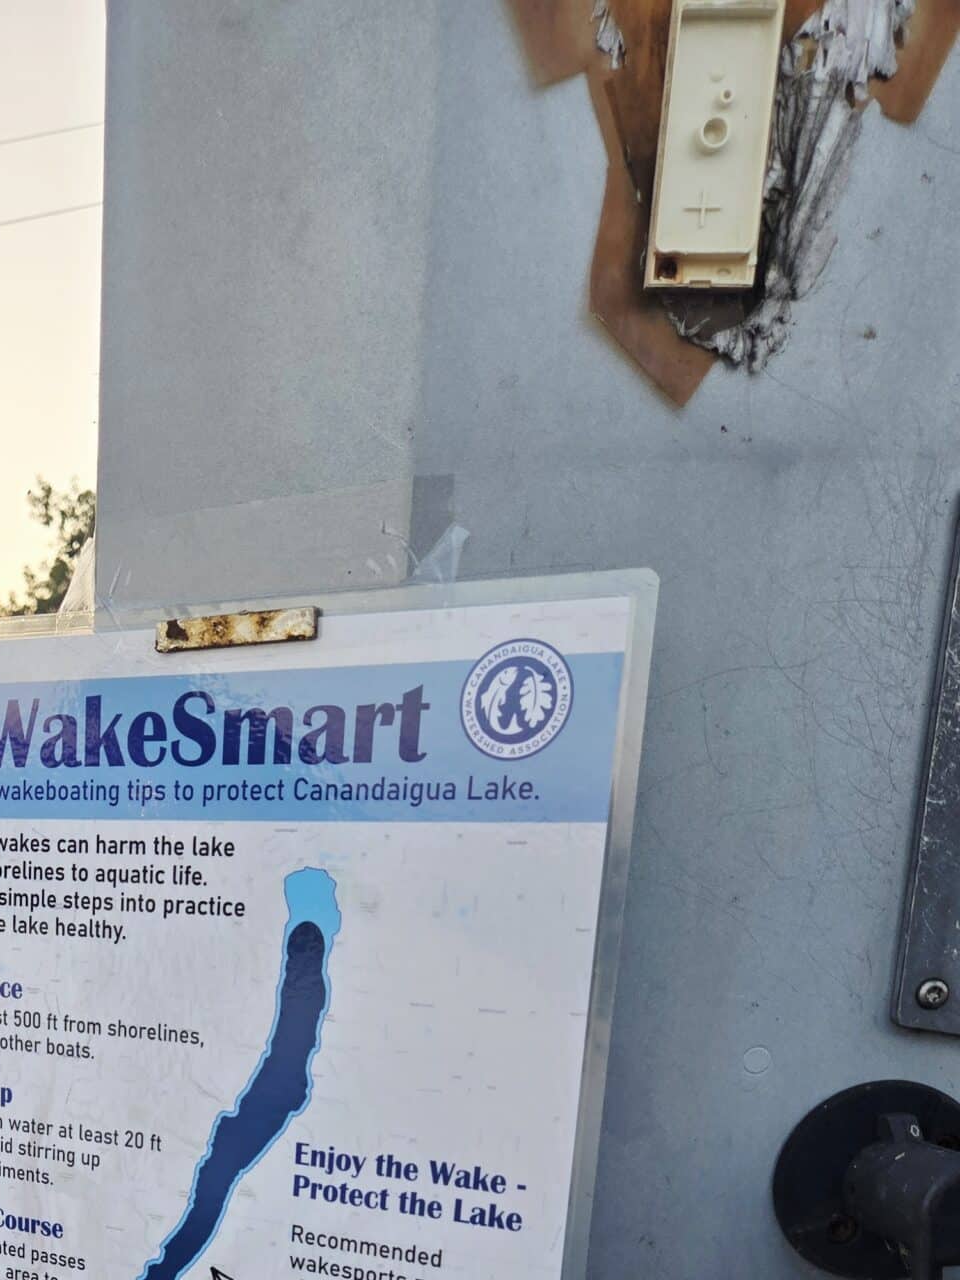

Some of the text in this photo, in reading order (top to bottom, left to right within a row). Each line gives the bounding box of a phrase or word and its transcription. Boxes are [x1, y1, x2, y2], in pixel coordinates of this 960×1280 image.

[471, 645, 566, 688] CANANDAIGUA LAKE
[465, 694, 568, 755] WATERSHED ASSOCIATION
[128, 779, 165, 806] tips
[175, 781, 193, 801] to
[203, 780, 284, 807] protect
[294, 777, 456, 807] Canandaigua
[468, 776, 539, 800] Lake.
[58, 839, 88, 853] can
[97, 835, 145, 854] harm
[154, 836, 184, 855] the
[193, 836, 234, 856] lake
[72, 864, 88, 881] to
[96, 865, 165, 888] aquatic
[173, 865, 206, 885] life.
[64, 892, 113, 915] steps
[121, 892, 155, 912] into
[164, 896, 245, 918] practice
[13, 915, 48, 934] lake
[56, 917, 125, 944] healthy.
[14, 1010, 40, 1029] 500
[47, 1013, 57, 1030] ft
[64, 1015, 101, 1034] from
[108, 1020, 203, 1047] shorelines,
[0, 1034, 40, 1052] other
[47, 1038, 94, 1059] boats.
[9, 1119, 53, 1135] water
[59, 1124, 72, 1139] at
[80, 1124, 118, 1145] least
[125, 1131, 143, 1149] 20
[151, 1134, 161, 1151] ft
[19, 1141, 75, 1167] stirring
[82, 1153, 100, 1170] up
[296, 1143, 506, 1193] Enjoy the Wake
[293, 1175, 522, 1231] Protect the Lake
[32, 1250, 85, 1270] passes
[291, 1225, 443, 1268] Recommended
